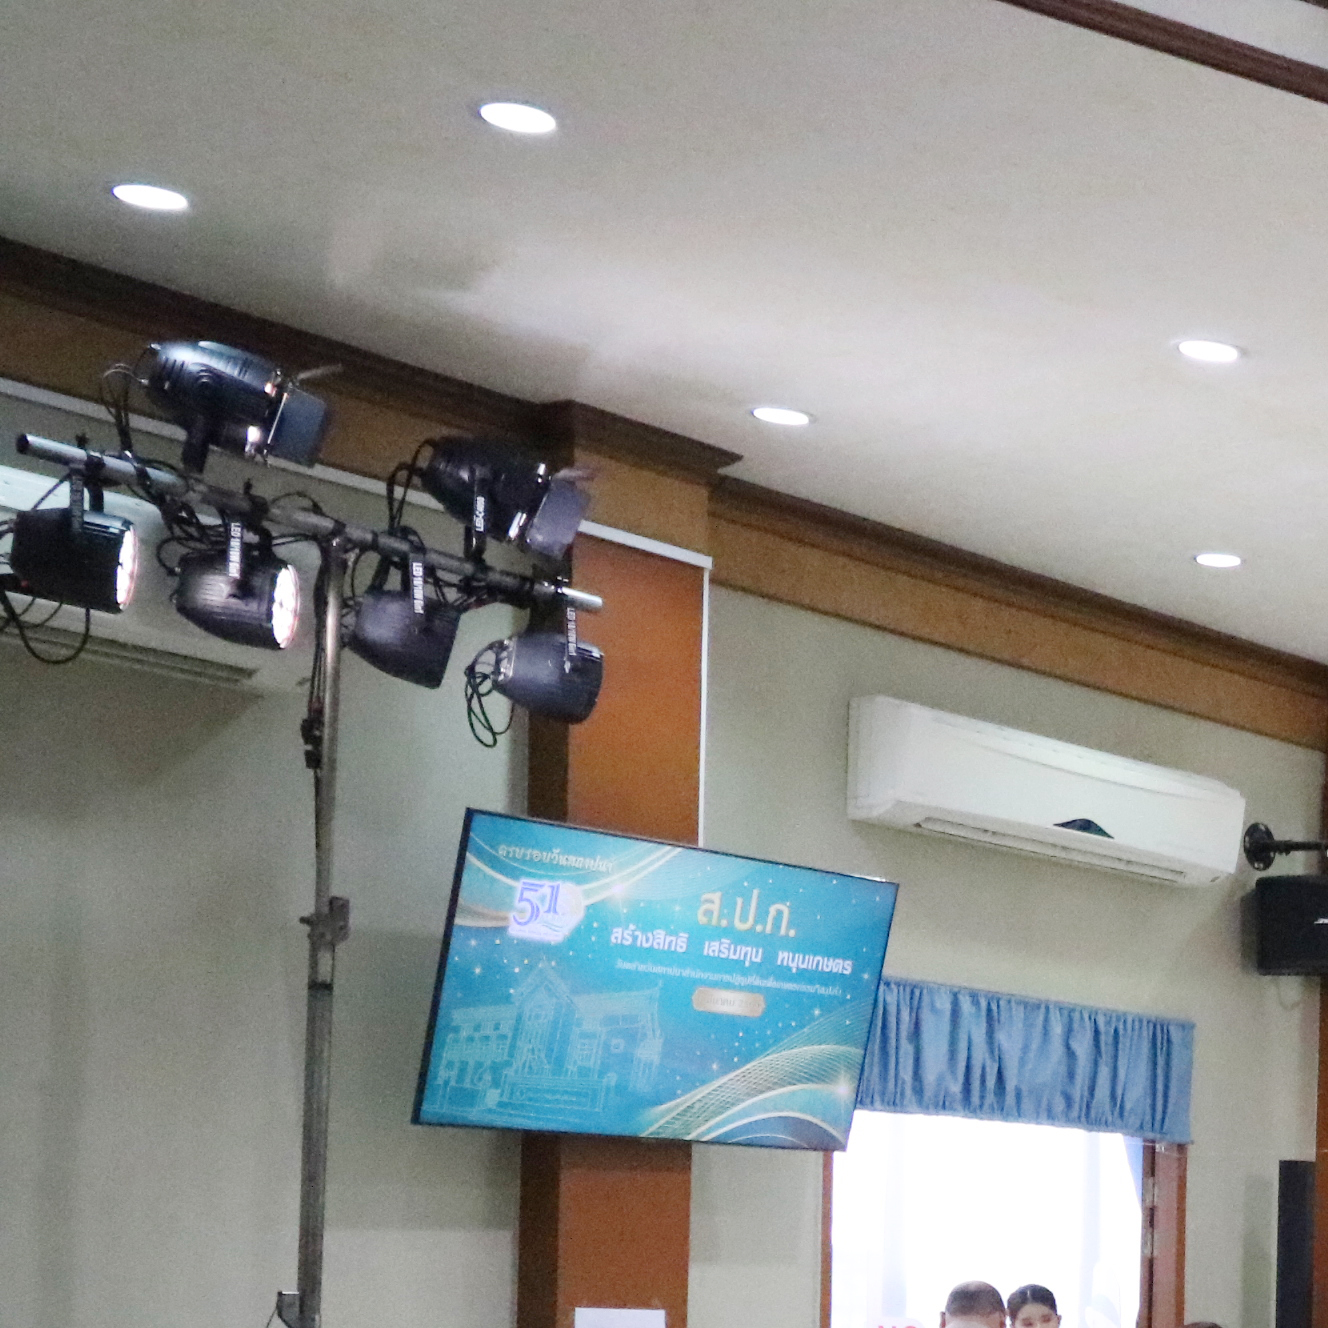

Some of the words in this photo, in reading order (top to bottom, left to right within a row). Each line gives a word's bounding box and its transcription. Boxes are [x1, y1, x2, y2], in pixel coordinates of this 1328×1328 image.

[512, 881, 560, 926] 51
[697, 888, 797, 938] ส.ป.ก.
[610, 923, 689, 953] สร้างสิทธิ
[703, 938, 763, 967] เสริมทุน
